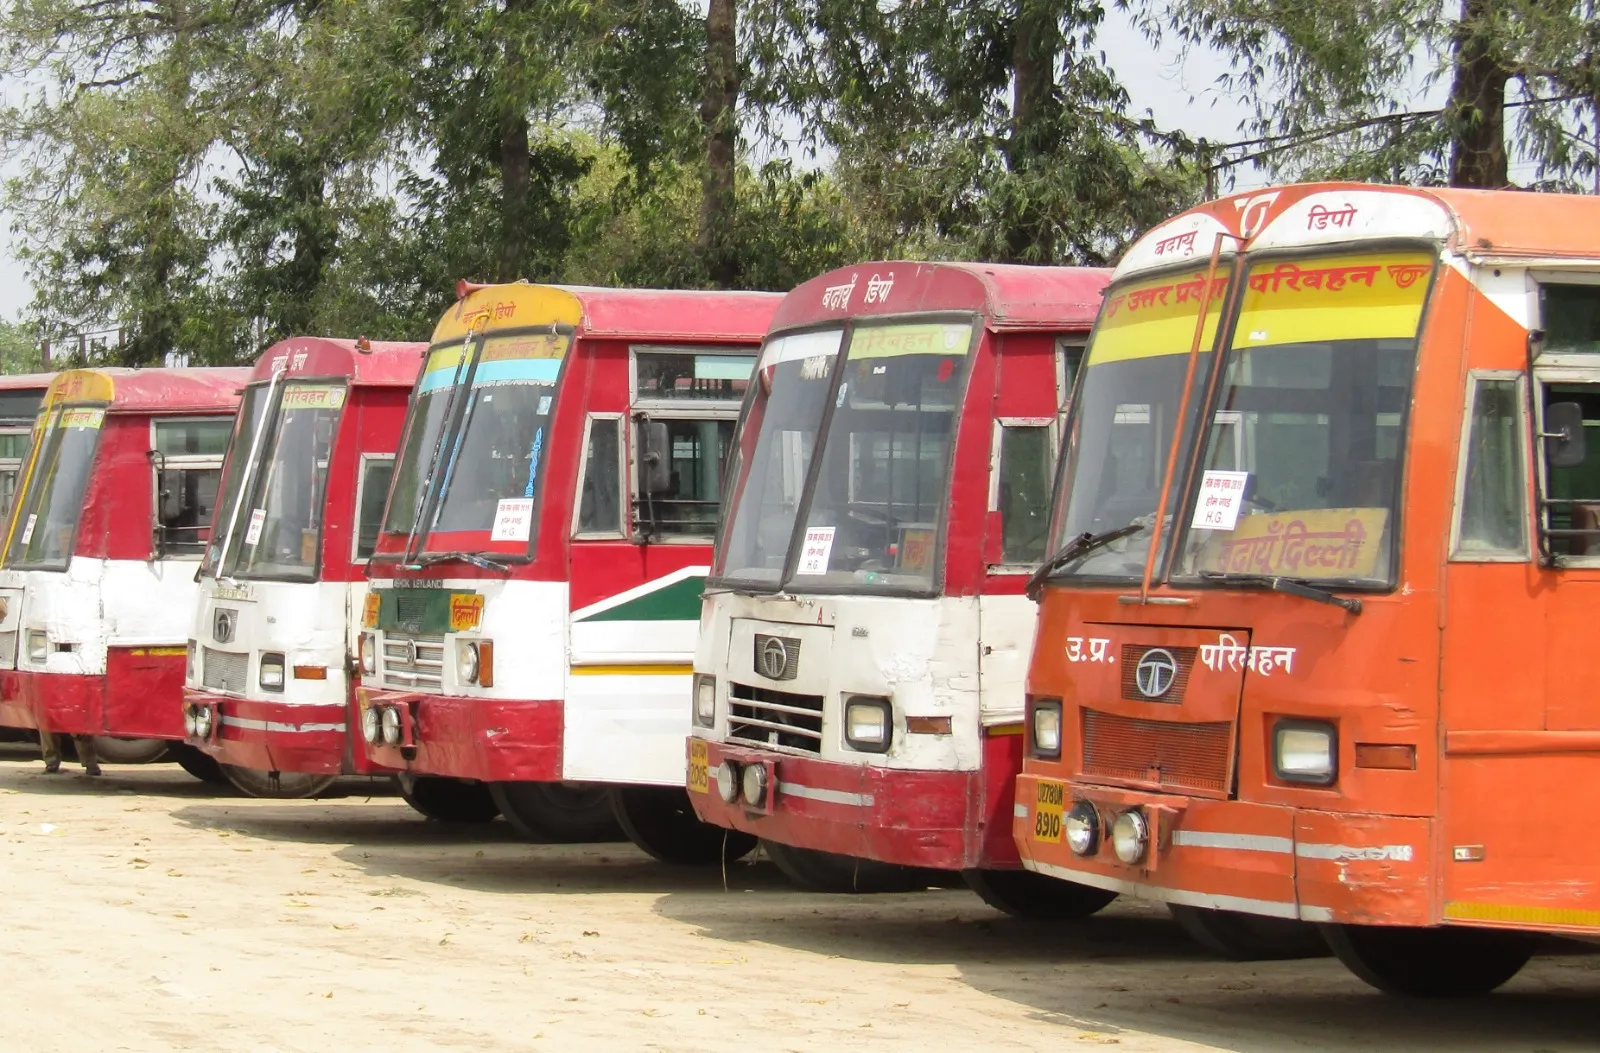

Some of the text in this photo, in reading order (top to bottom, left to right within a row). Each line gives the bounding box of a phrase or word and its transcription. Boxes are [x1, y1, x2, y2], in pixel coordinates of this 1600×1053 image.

[1307, 203, 1358, 231] डिपो
[822, 271, 894, 312] बदायूँ डिपो
[1128, 285, 1174, 312] उत्तर
[1249, 263, 1382, 295] परिवहन
[495, 301, 516, 320] डिपो
[284, 385, 328, 405] परिवहन
[1278, 518, 1367, 571] दिल्ली
[452, 597, 479, 626] दिल्ली
[817, 605, 823, 625] A
[1065, 633, 1297, 676] उ.प्र. परिवहन
[1035, 811, 1060, 838] 8910
